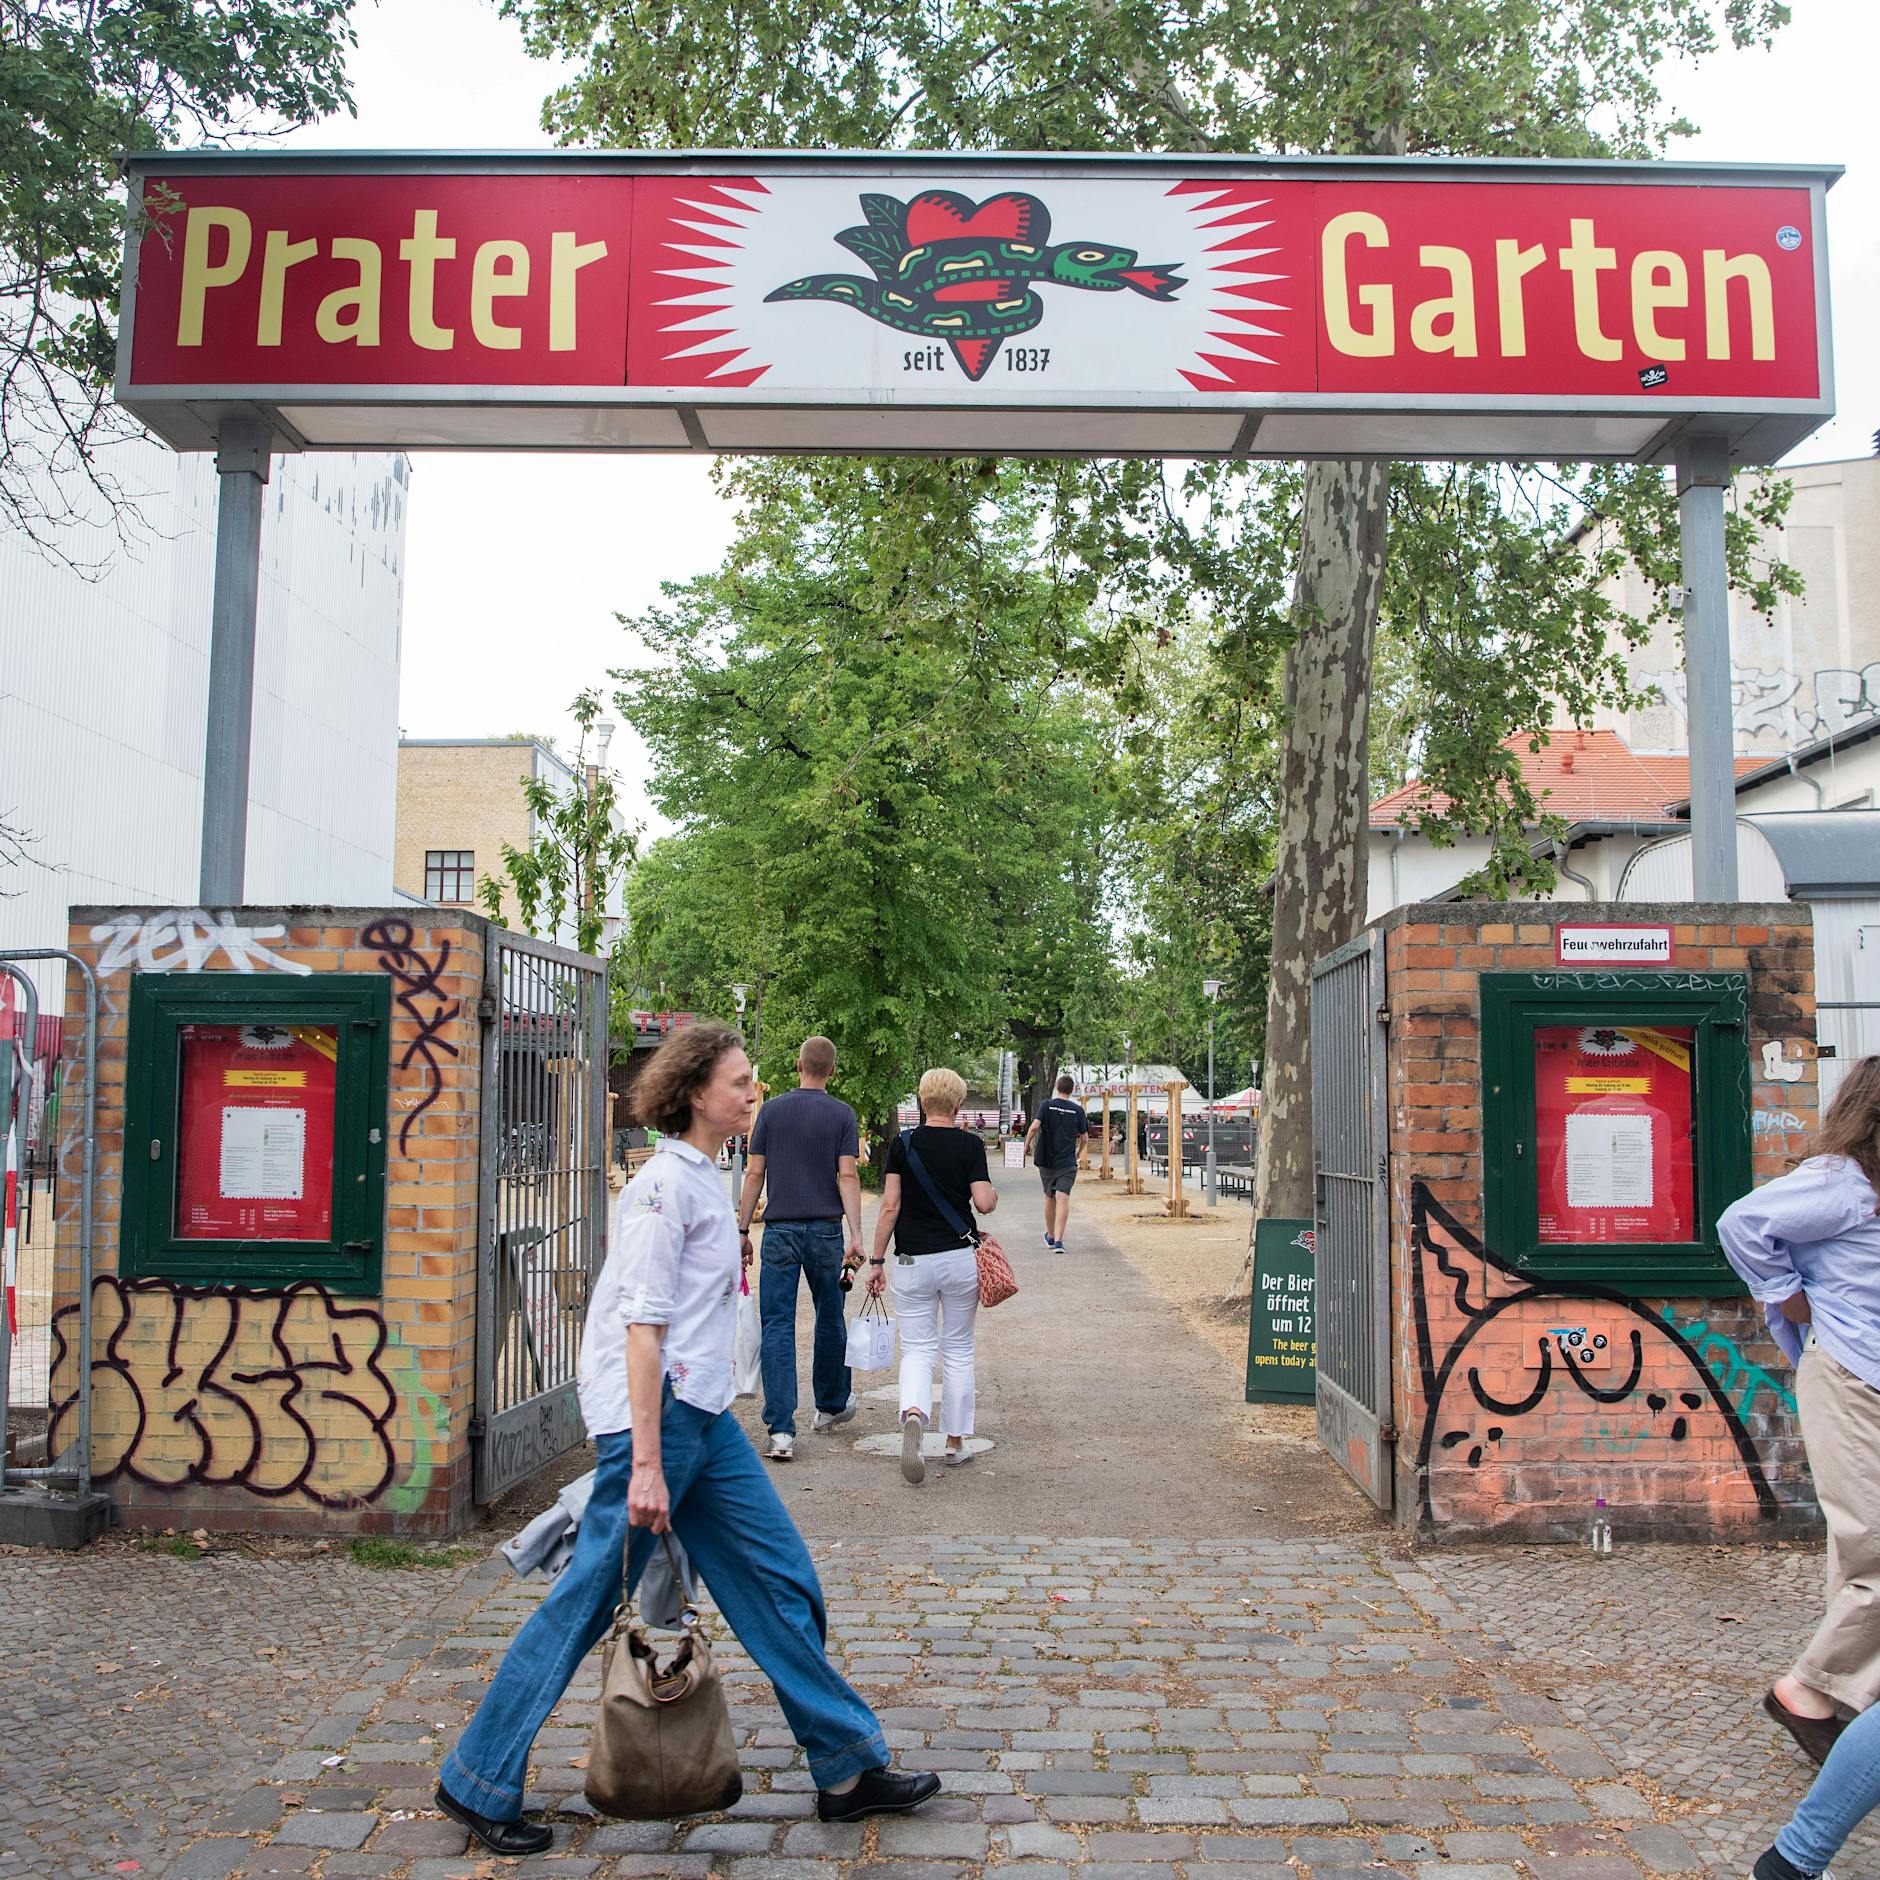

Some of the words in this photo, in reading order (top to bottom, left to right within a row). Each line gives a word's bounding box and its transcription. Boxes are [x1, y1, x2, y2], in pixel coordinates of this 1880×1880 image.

[177, 206, 608, 351] Prater
[1322, 211, 1776, 362] Garten
[903, 345, 944, 371] seit
[1005, 348, 1051, 372] 1837
[1262, 1273, 1284, 1291] Der
[1267, 1294, 1309, 1312] öffnet
[1272, 1318, 1293, 1332] um
[1297, 1316, 1312, 1333] 12
[1273, 1338, 1288, 1351] The
[1290, 1338, 1309, 1352] beer
[1255, 1354, 1279, 1367] opens
[1281, 1354, 1306, 1368] today
